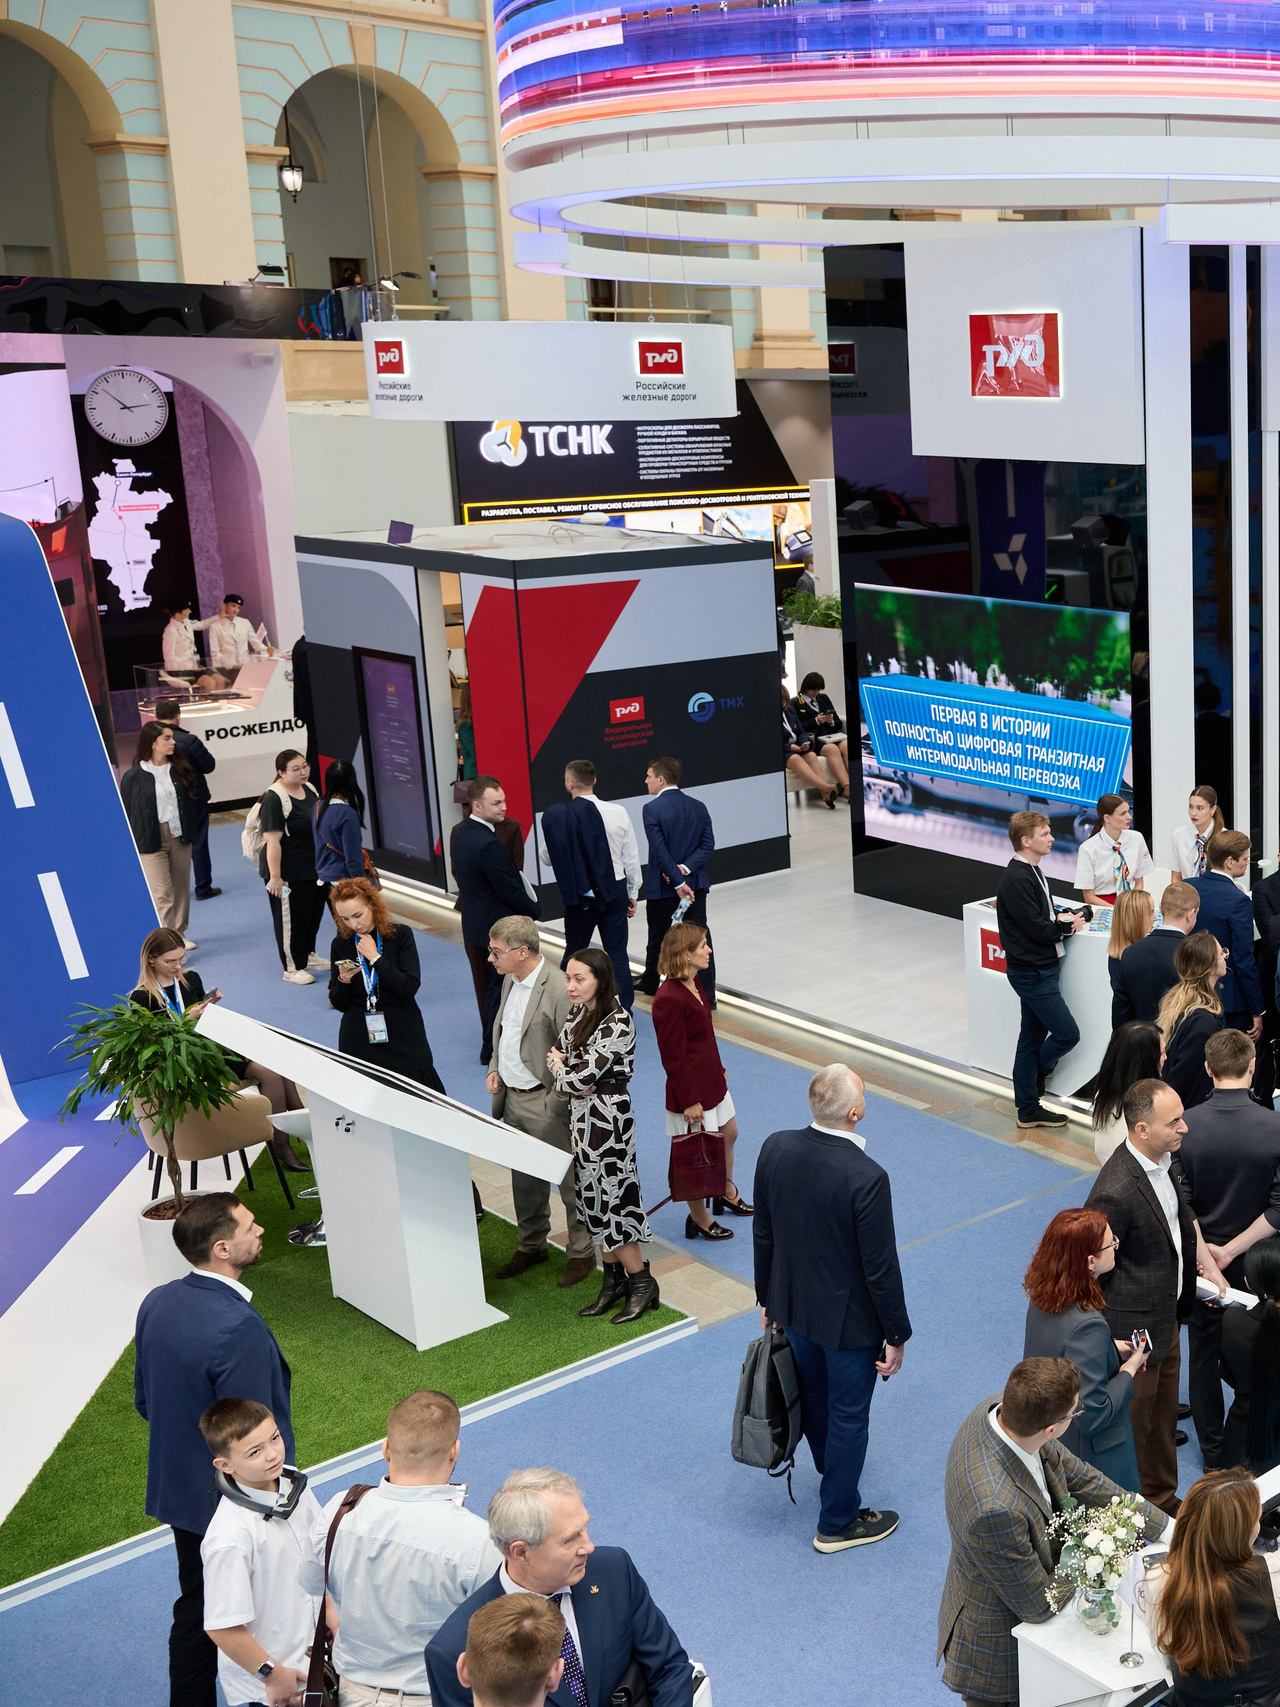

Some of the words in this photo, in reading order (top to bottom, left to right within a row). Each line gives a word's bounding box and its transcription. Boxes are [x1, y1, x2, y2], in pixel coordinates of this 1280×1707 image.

[378, 381, 411, 391] Российские
[636, 381, 686, 391] Российские
[399, 394, 423, 403] дороги
[622, 393, 668, 402] железные
[670, 393, 697, 403] дороги
[528, 424, 614, 456] ТСНК
[481, 508, 523, 518] РАЗРАБОТКА,
[523, 506, 557, 515] ПОСТАВКА,
[588, 502, 622, 511] СЕРВИСНОЕ
[623, 500, 668, 509] ОБСЛУЖИВАНИЕ
[669, 495, 740, 506] ПОИСКОВО-ДОСМОТРОВОЙ
[746, 492, 788, 501] РЕНТГЕНОВСКОЙ
[604, 721, 652, 735] Федеральная
[931, 704, 977, 727] ПЕРВАЯ
[981, 714, 988, 729] В
[992, 715, 1051, 739] ИСТОРИИ
[205, 718, 306, 741] РОСЖЕЛДО
[604, 729, 653, 742] пассажирская
[611, 738, 647, 749] компания
[884, 720, 954, 746] ПОЛНОСТЬЮ
[957, 731, 1022, 759] ЦИФРОВАЯ
[1025, 745, 1105, 773] ТРАНЗИТНАЯ
[906, 745, 1011, 777] ИНТЕРМОДАЛЬНАЯ
[1014, 765, 1081, 790] ПЕРЕВОЗКА
